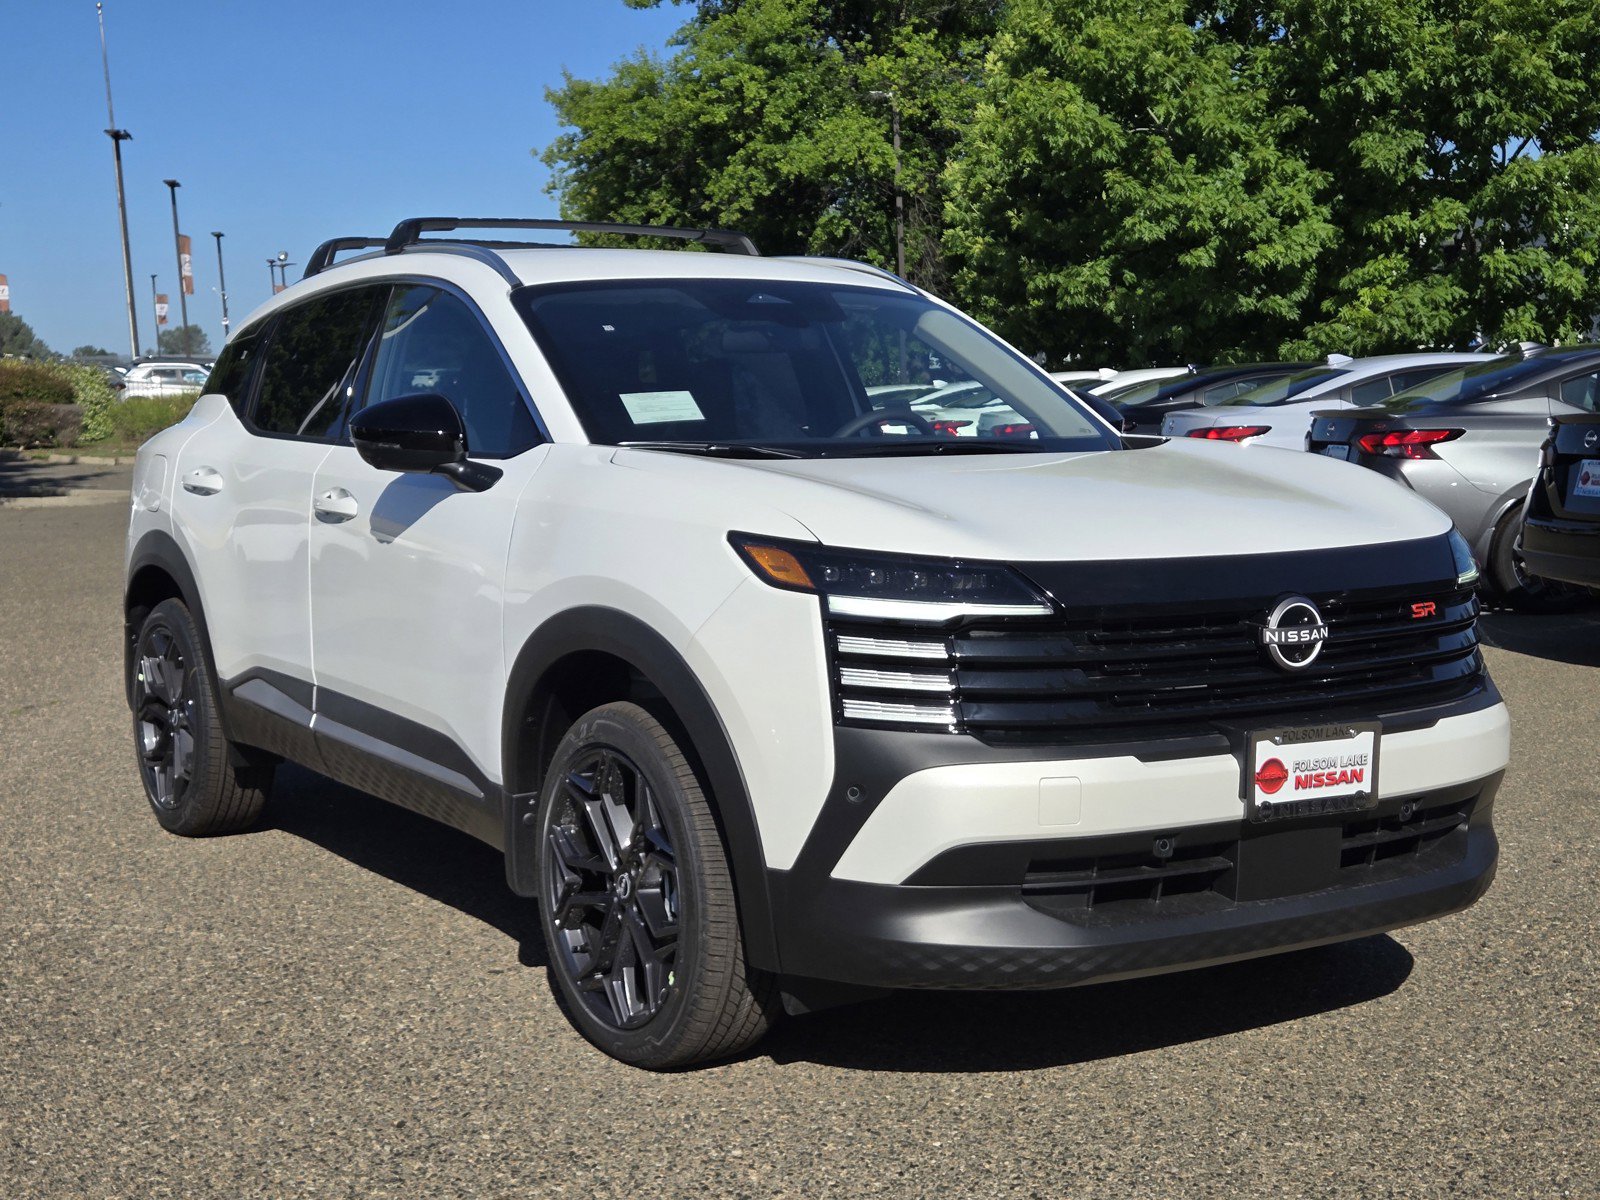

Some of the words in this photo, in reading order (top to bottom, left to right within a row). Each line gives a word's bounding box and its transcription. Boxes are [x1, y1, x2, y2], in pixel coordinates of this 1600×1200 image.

[1412, 602, 1436, 618] SR
[1265, 627, 1328, 642] NISSAN
[1282, 727, 1324, 740] FOLSOM
[1326, 725, 1352, 736] LAKE
[1292, 757, 1338, 772] FOLSOM
[1340, 754, 1368, 768] LAKE
[1294, 768, 1364, 790] NISSAN
